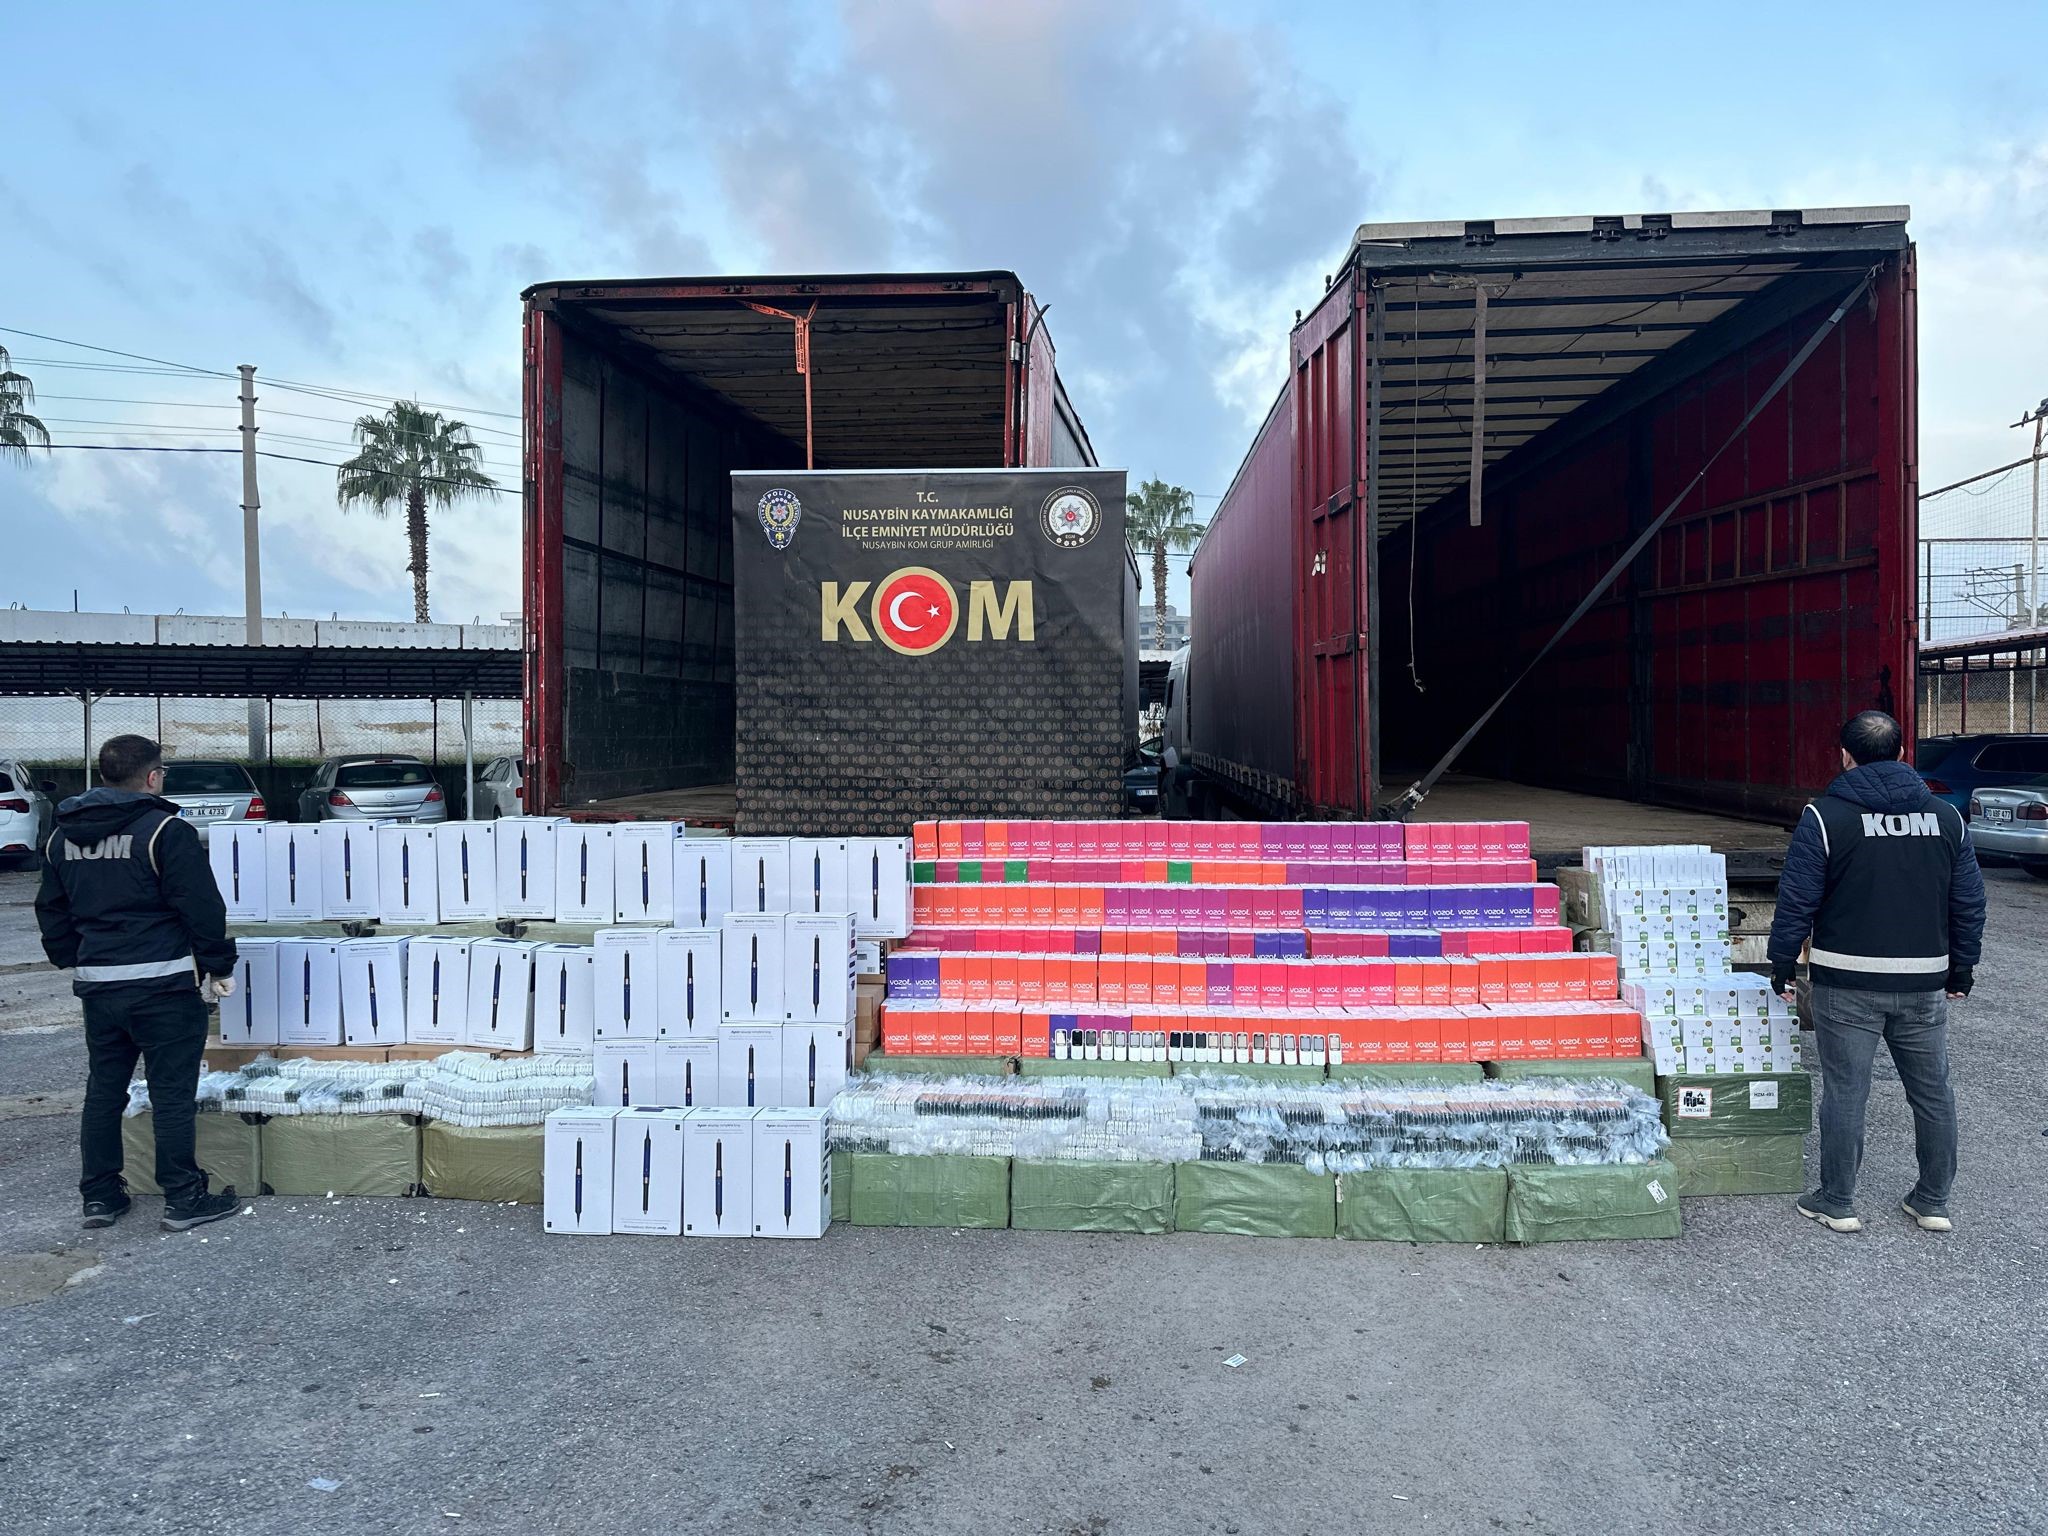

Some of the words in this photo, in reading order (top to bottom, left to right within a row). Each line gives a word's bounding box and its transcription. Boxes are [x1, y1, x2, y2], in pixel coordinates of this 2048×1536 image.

[916, 492, 938, 502] T.C.
[843, 506, 908, 520] NUSAYBİN
[912, 506, 1013, 520] KAYMAKAMLIĞI
[842, 524, 868, 540] İLÇE
[872, 524, 927, 537] EMNİYET
[930, 522, 1014, 536] MÜDÜRLÜĞÜ
[908, 540, 928, 549] KOM
[930, 540, 954, 549] GRUP
[821, 566, 1035, 656] KOM
[1860, 812, 1940, 836] KOM
